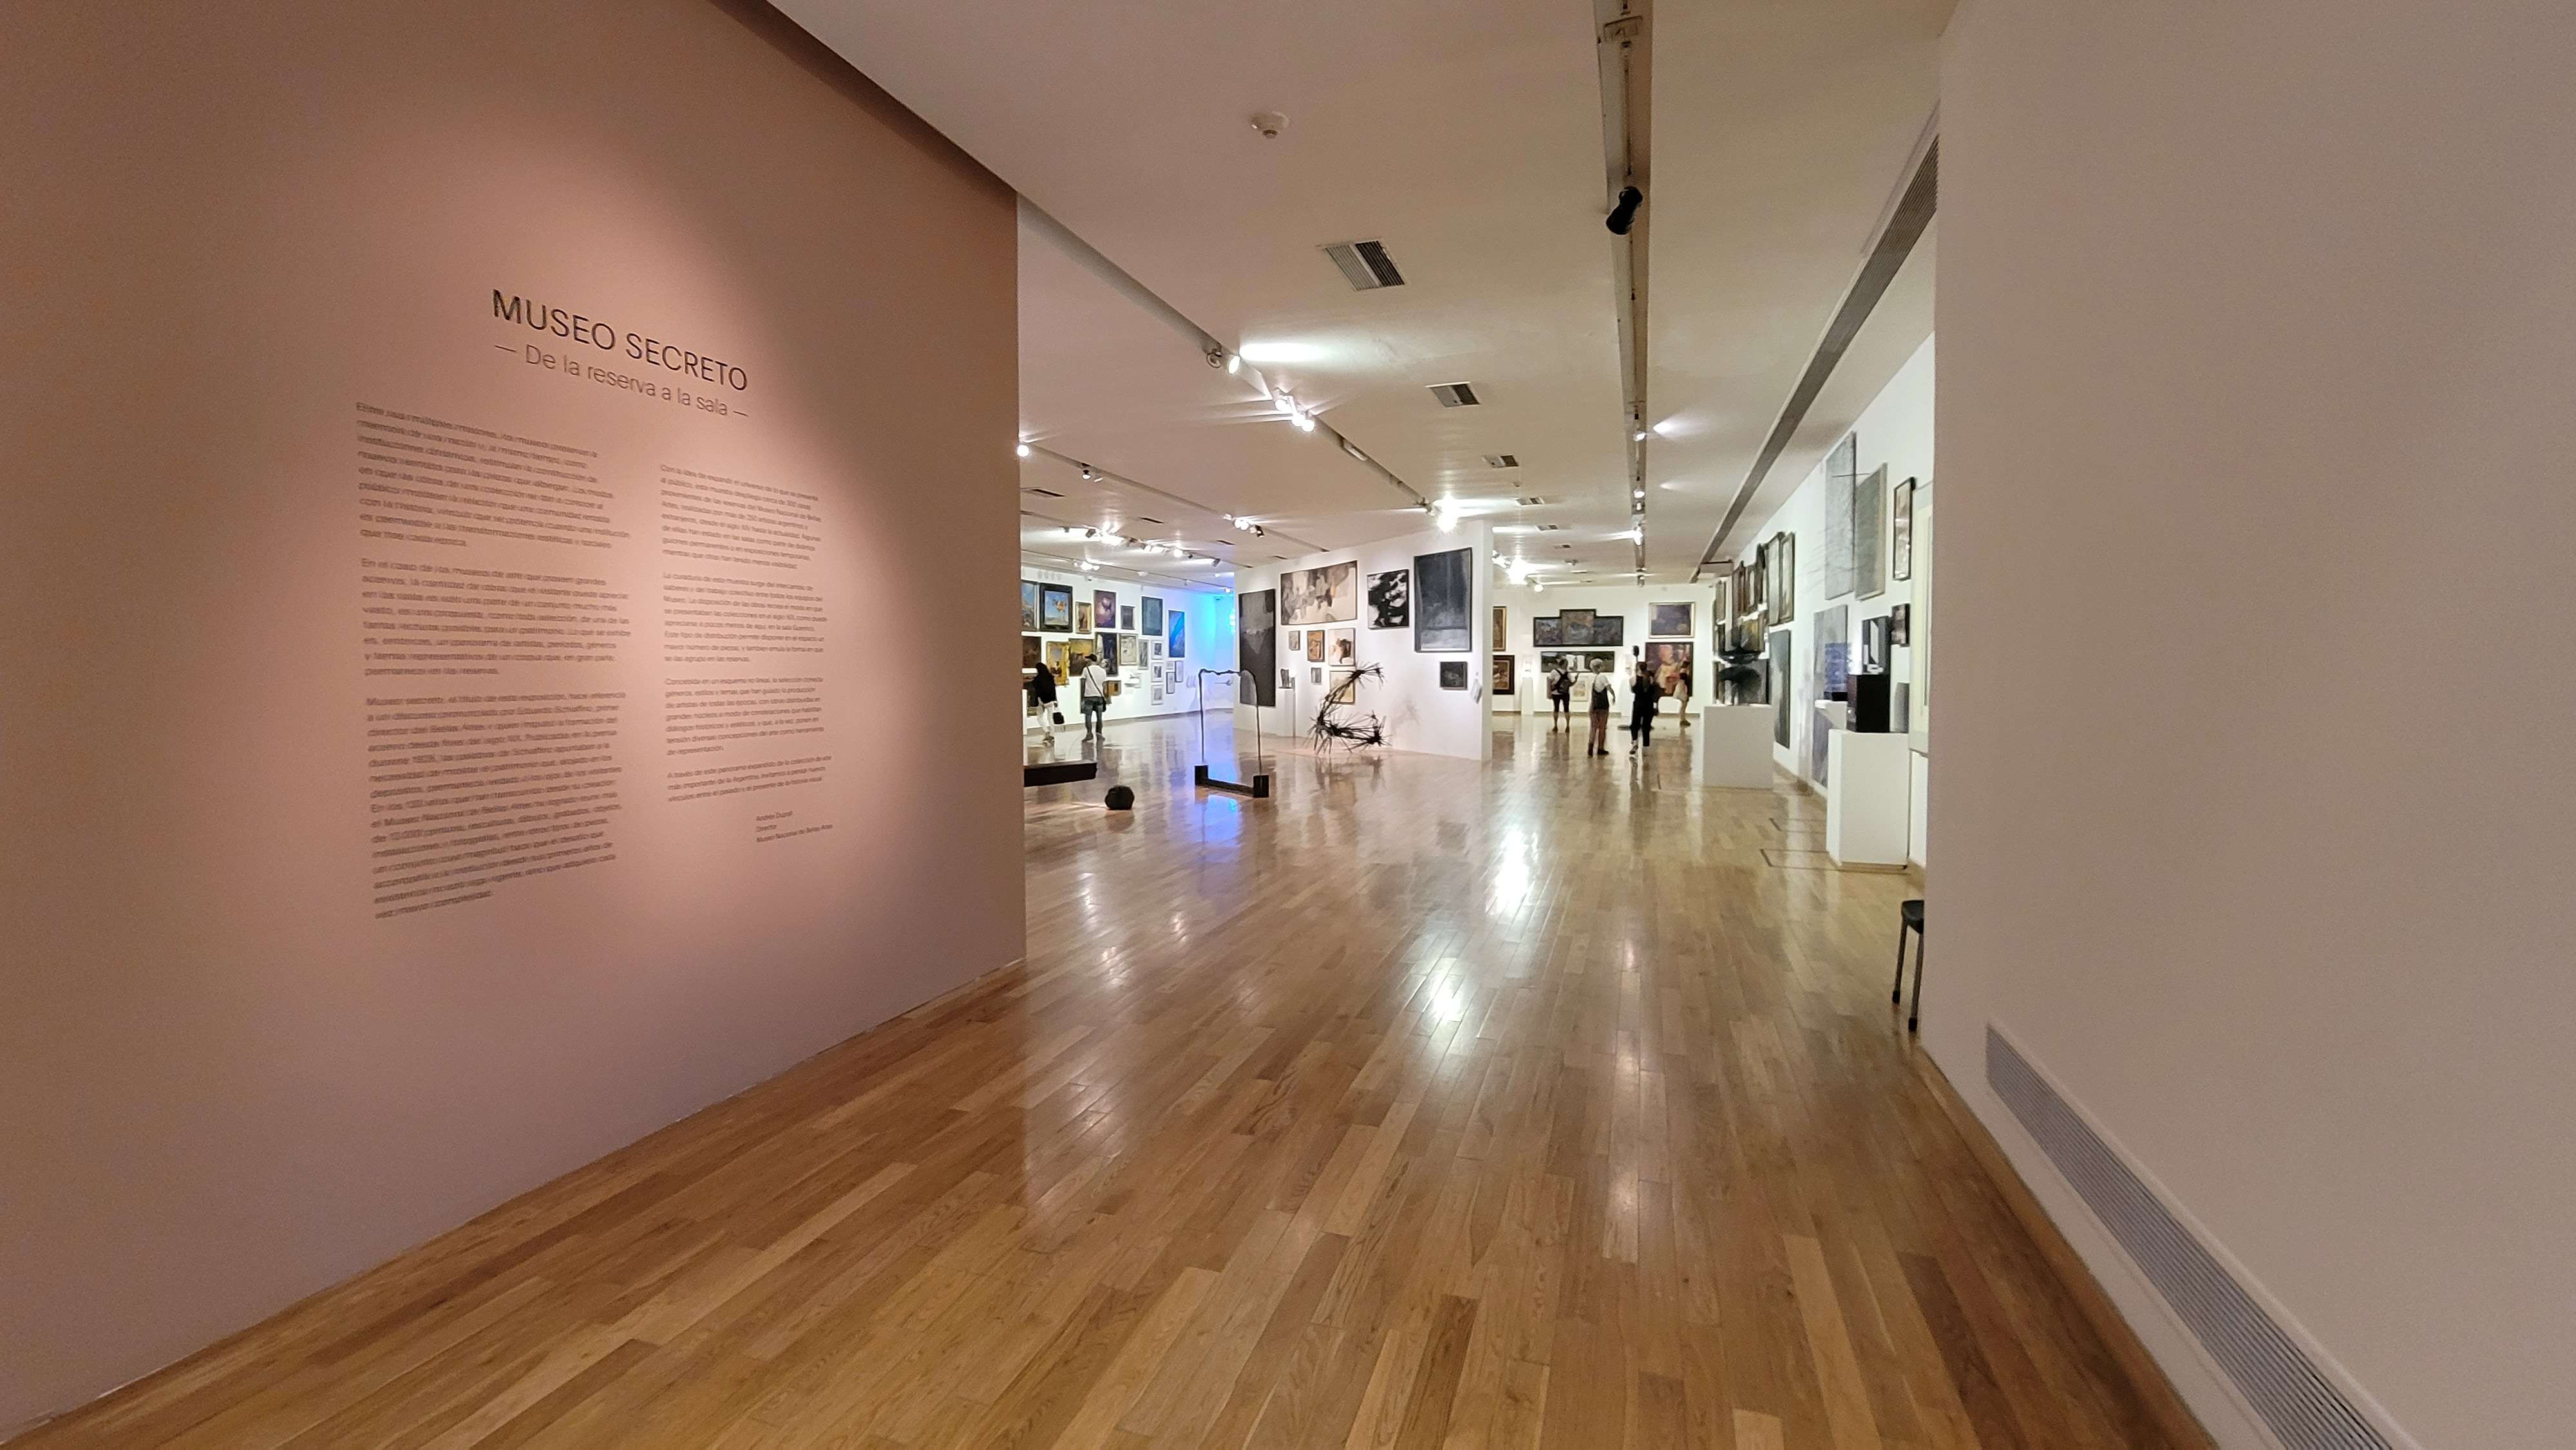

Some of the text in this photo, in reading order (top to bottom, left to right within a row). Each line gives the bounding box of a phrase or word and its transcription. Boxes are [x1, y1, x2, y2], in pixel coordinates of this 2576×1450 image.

[493, 289, 748, 390] MUSEO SECRETO
[526, 344, 556, 370] De
[564, 355, 580, 377] la
[587, 365, 656, 397] reserva
[661, 387, 672, 401] a
[677, 388, 691, 406] la
[696, 396, 728, 416] sala
